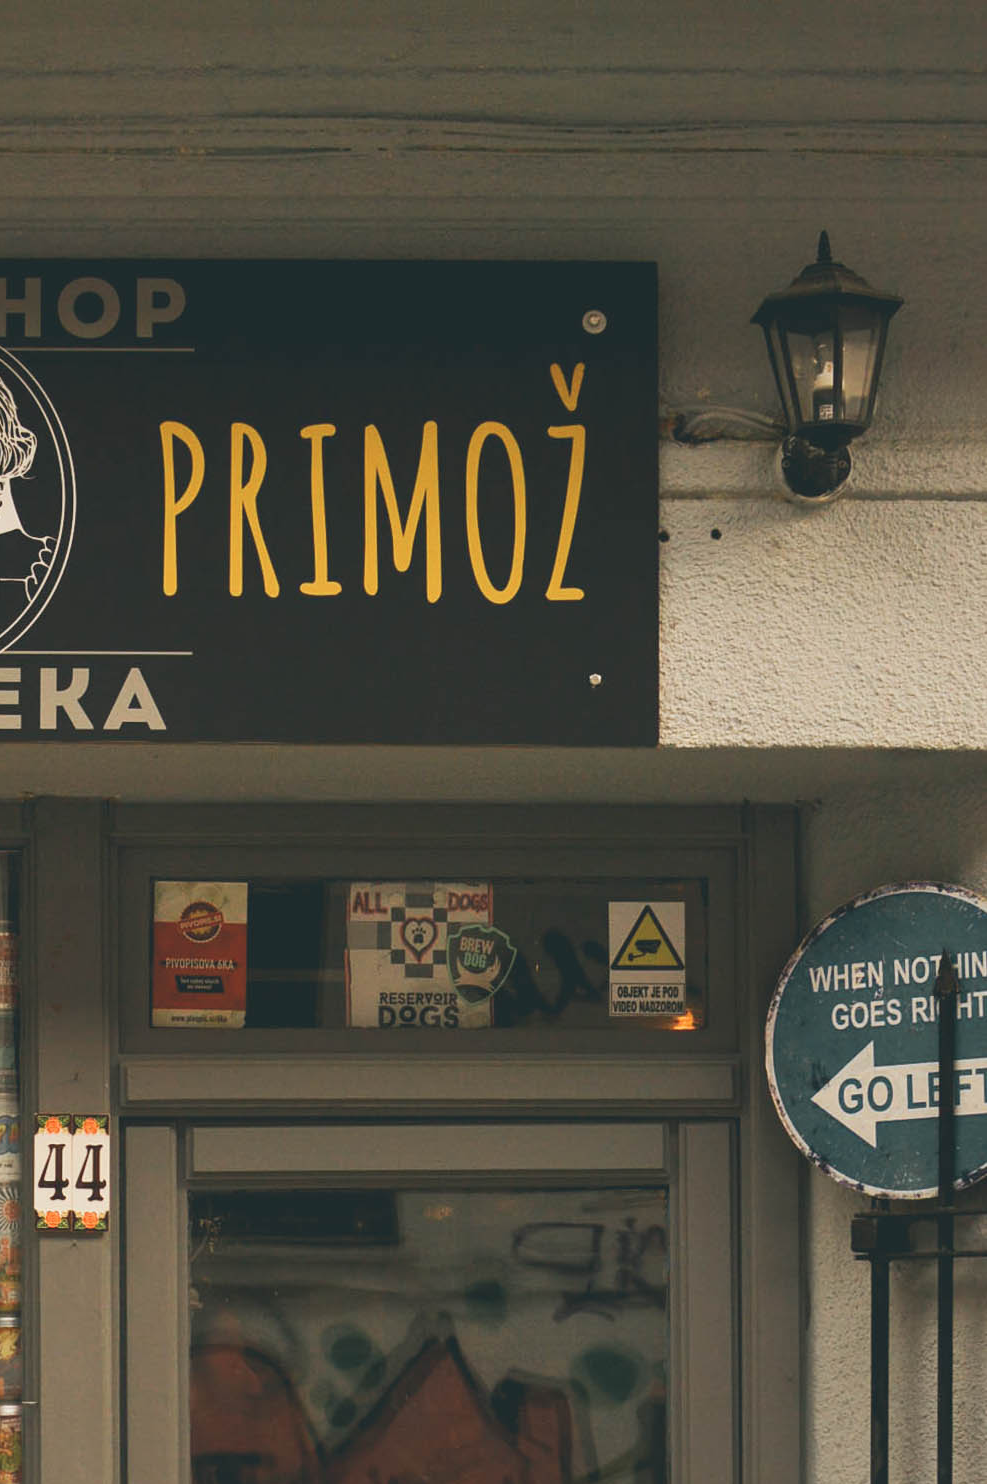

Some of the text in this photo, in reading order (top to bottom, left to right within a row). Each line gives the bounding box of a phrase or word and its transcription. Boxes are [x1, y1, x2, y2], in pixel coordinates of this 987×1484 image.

[159, 362, 586, 605] PRIMOŽ
[352, 891, 489, 914] ALL DOGS
[460, 936, 495, 955] BREW
[464, 953, 487, 968] DOG
[809, 960, 884, 993] WHEN
[379, 991, 459, 1005] RESERVOIR
[616, 985, 680, 999] OBJEKT JE POD
[377, 1005, 460, 1029] DOGS
[613, 1000, 684, 1013] VIDEO NADZOROM
[831, 992, 987, 1031] GOES RIHT
[837, 1076, 894, 1115] GO
[38, 1143, 107, 1202] 44
